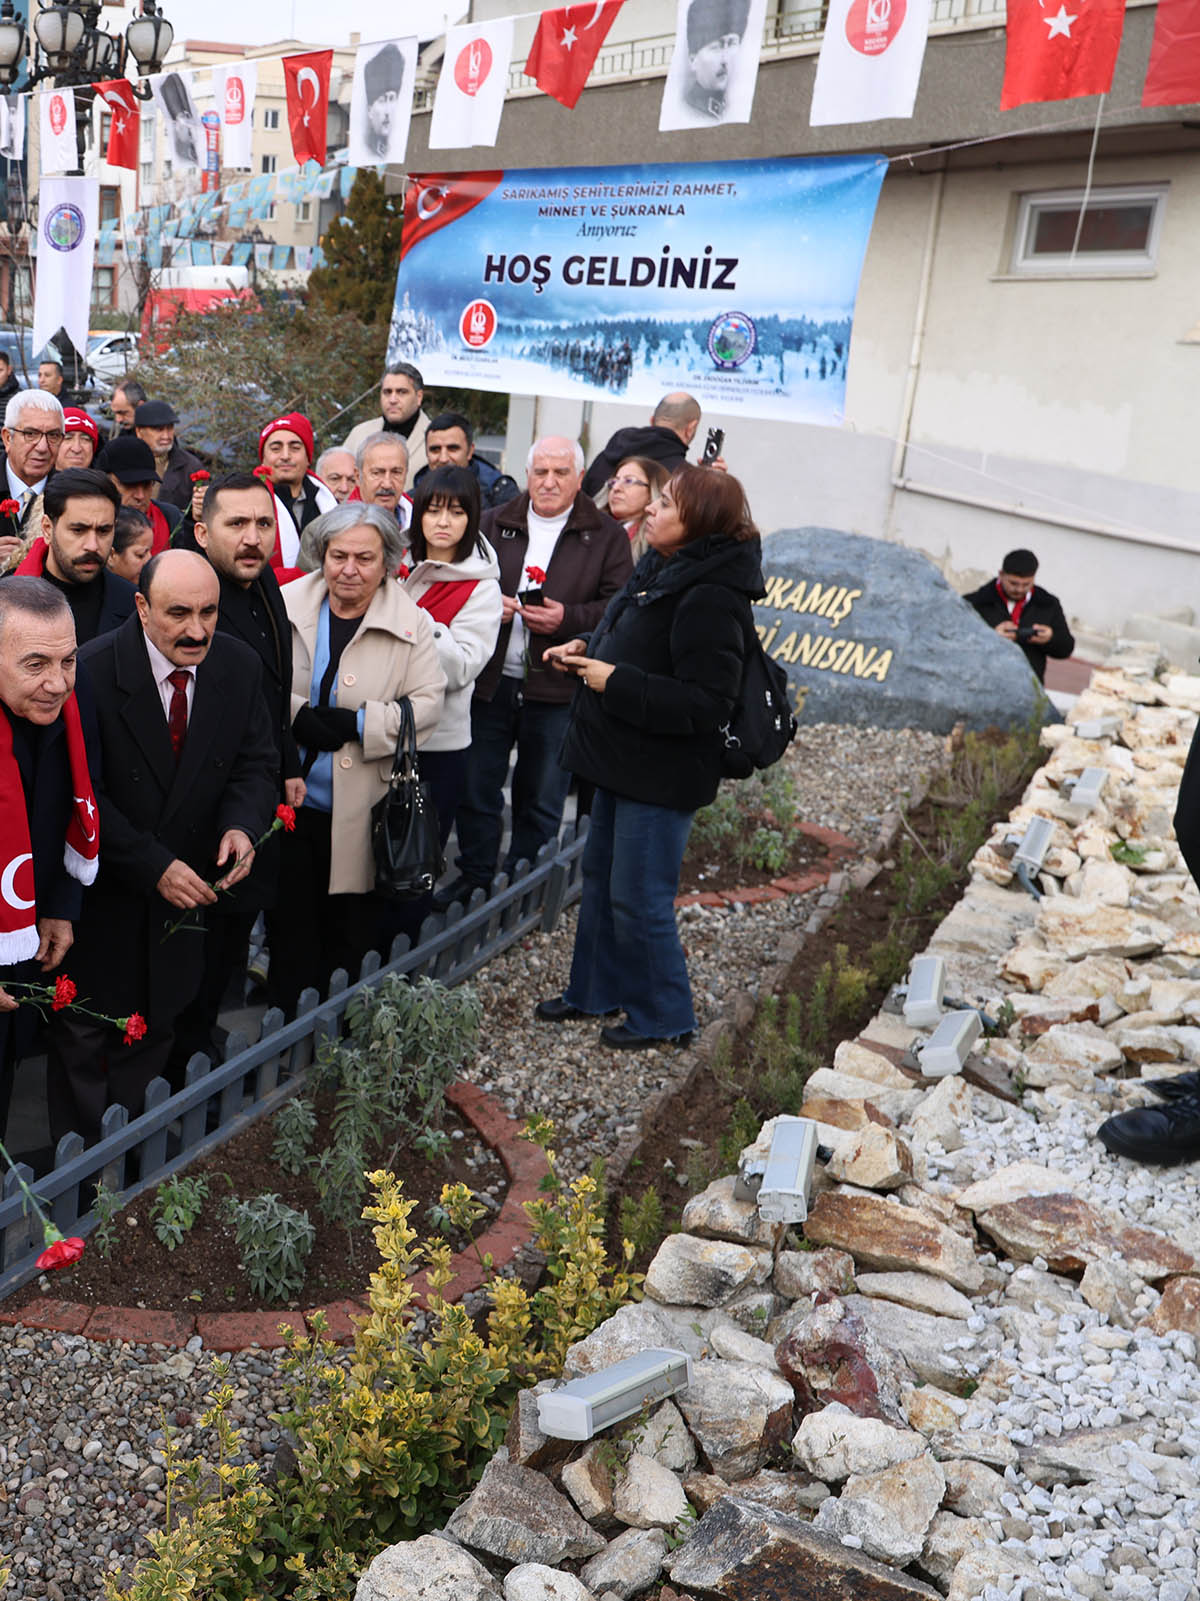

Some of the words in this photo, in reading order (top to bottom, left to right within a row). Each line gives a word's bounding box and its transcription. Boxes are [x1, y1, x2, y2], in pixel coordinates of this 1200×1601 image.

[502, 187, 569, 201] SARIKAMIŞ
[573, 180, 669, 200] ŞEHİTLERİMİZİ
[673, 183, 737, 197] RAHMET,
[538, 203, 585, 217] MİNNET
[591, 205, 607, 217] VE
[610, 202, 685, 219] ŞÜKRANLA
[577, 222, 638, 241] Anıyoruz
[484, 254, 551, 293] HOŞ
[562, 245, 739, 290] GELDİNİZ
[751, 576, 862, 628] IKAMIŞ
[772, 631, 893, 682] ANISINA
